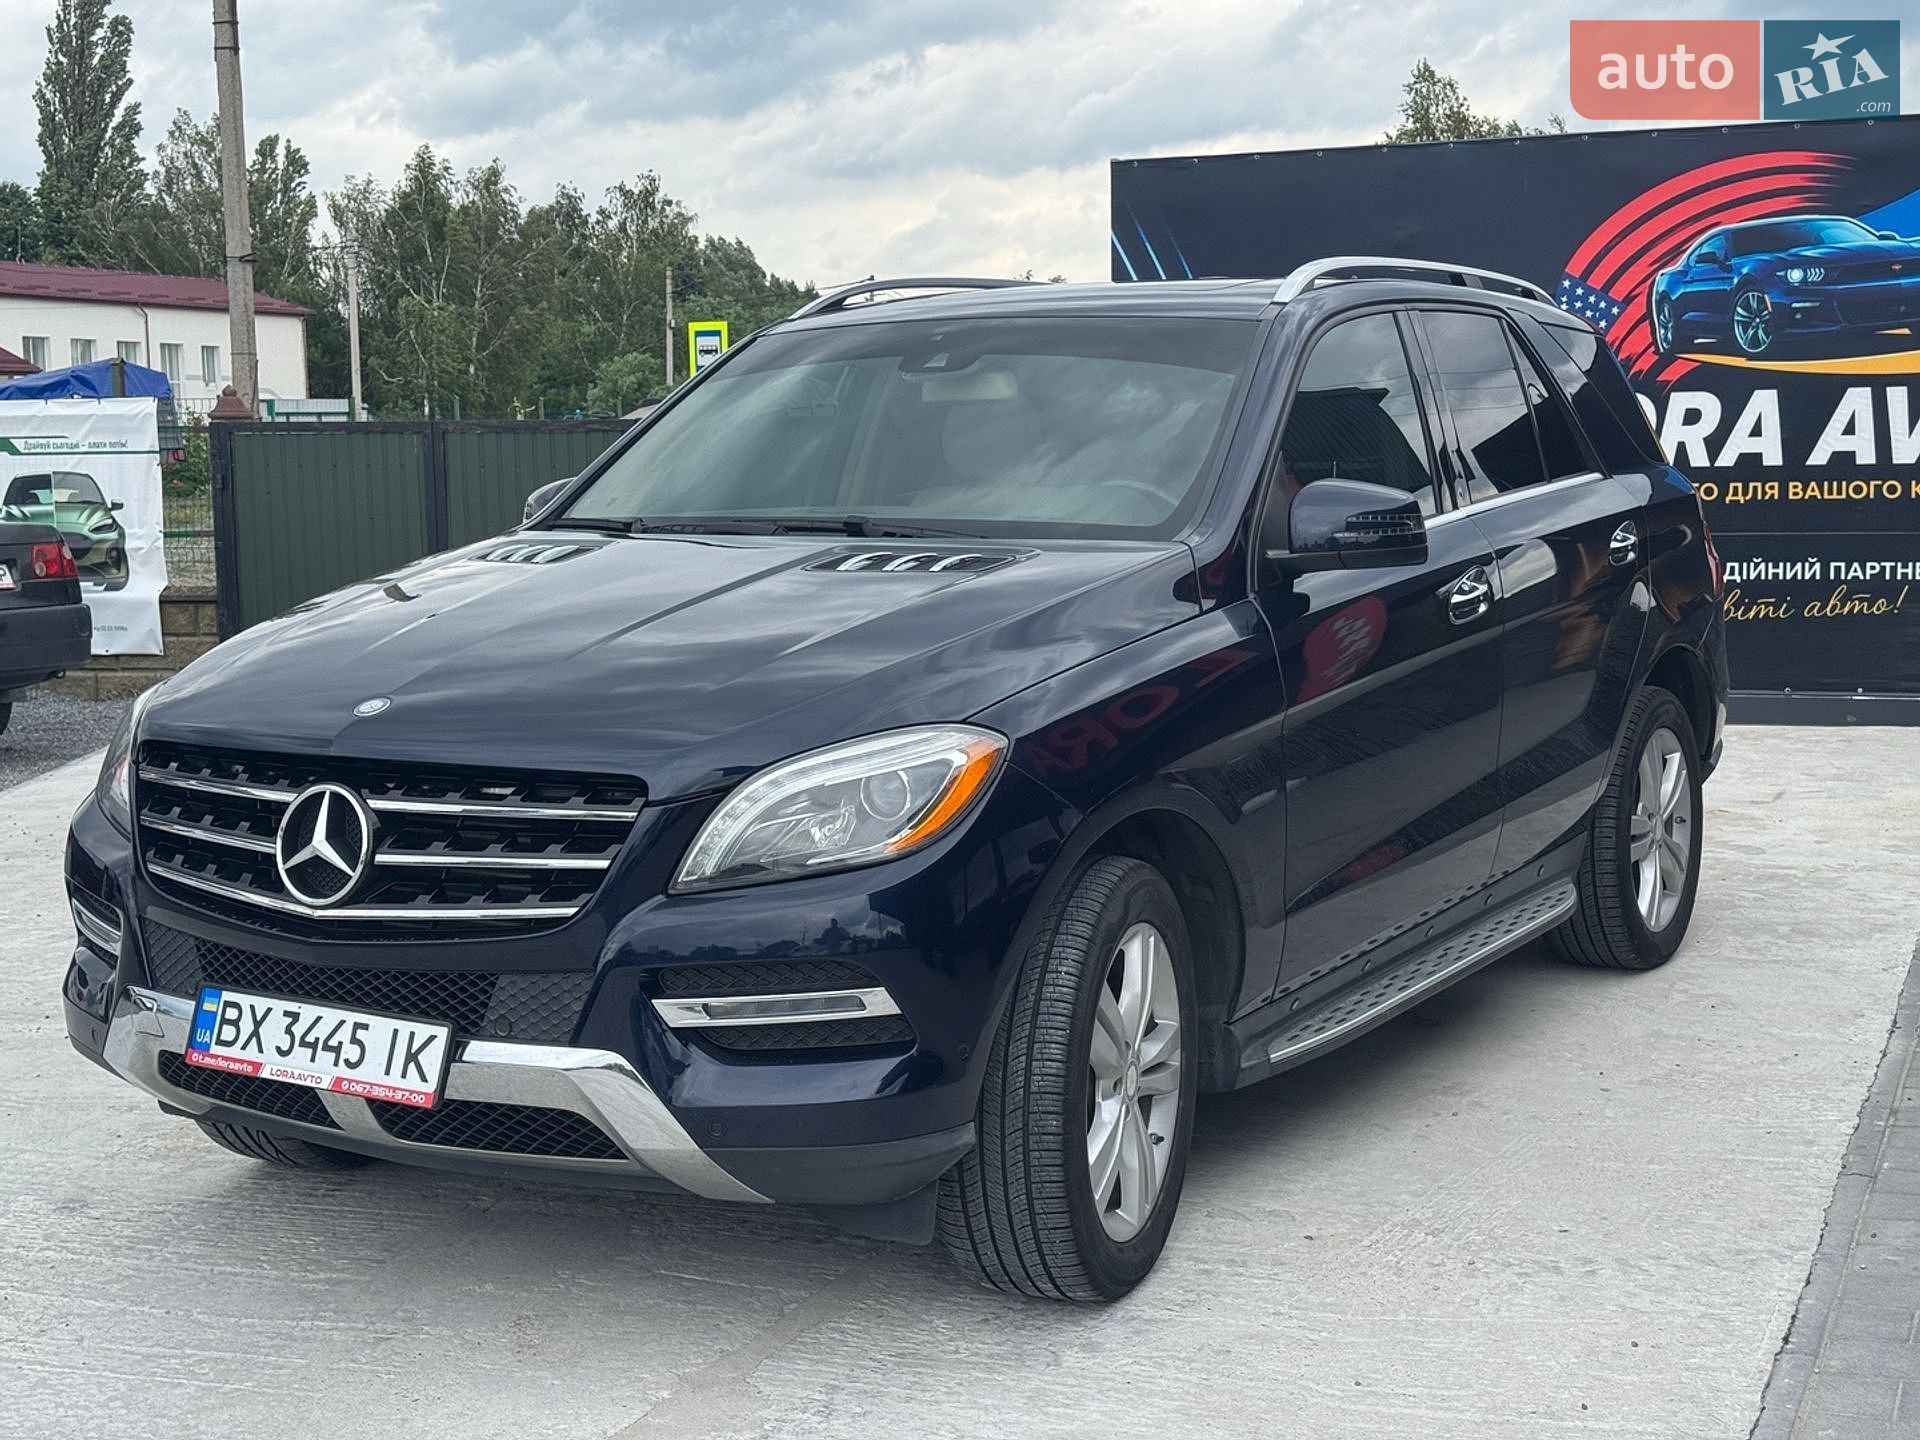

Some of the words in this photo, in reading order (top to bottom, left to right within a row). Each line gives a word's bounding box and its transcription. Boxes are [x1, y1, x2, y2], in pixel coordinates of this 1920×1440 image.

[1725, 482, 1779, 504] ДЛЯ
[1788, 480, 1902, 500] ВАШОГО
[1803, 584, 1909, 618] авто!
[196, 1028, 211, 1045] UA
[215, 1000, 273, 1054] BX
[274, 1010, 370, 1070] 3445
[384, 1028, 438, 1084] IK
